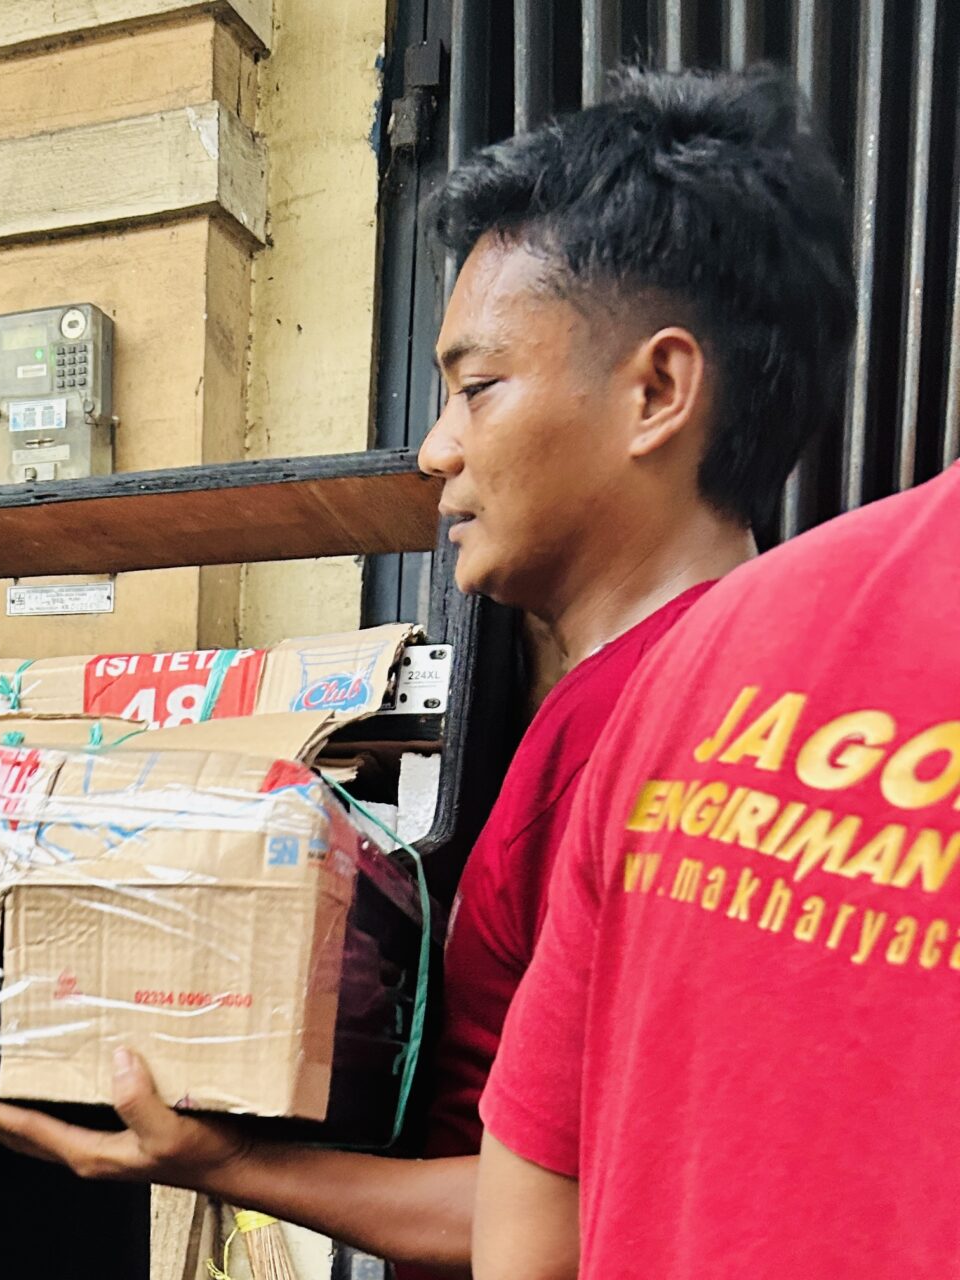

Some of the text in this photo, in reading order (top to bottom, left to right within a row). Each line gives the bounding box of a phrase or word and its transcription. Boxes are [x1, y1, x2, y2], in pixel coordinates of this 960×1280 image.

[94, 655, 140, 678] ISI
[408, 670, 441, 680] 224XL
[120, 683, 208, 731] 48
[693, 685, 960, 811] JAGO
